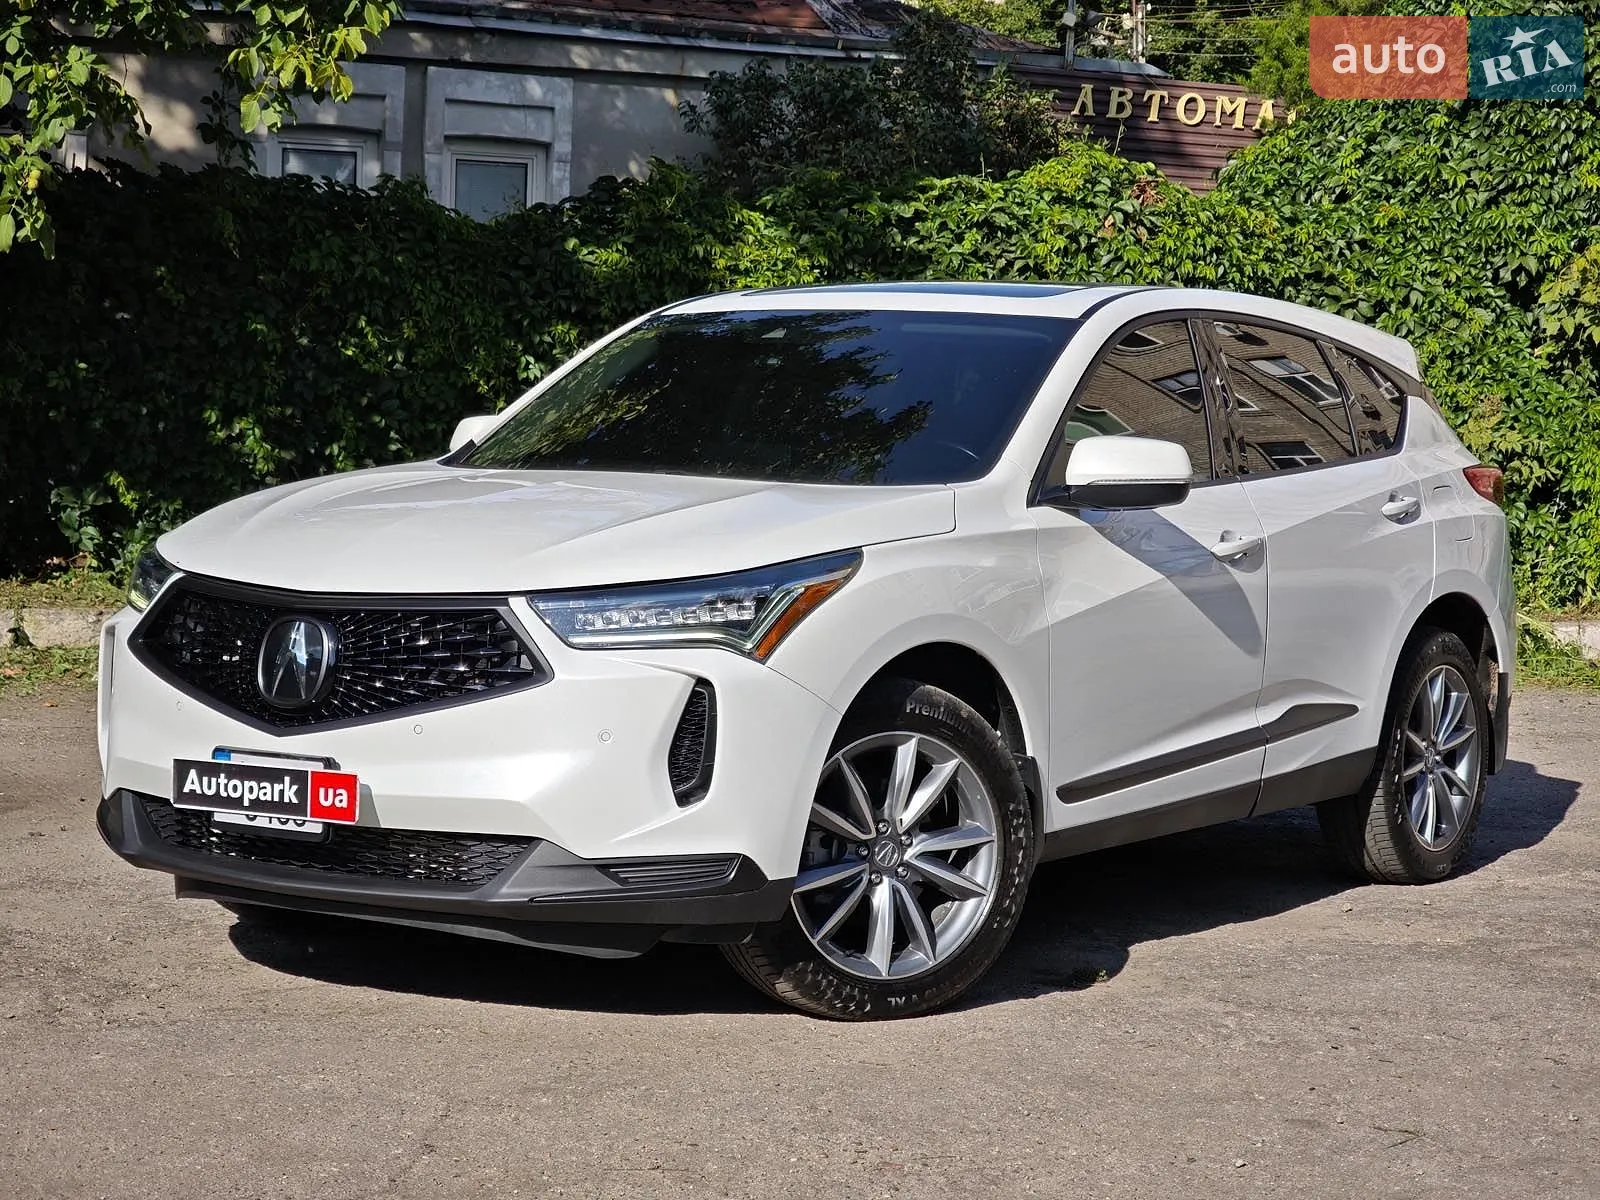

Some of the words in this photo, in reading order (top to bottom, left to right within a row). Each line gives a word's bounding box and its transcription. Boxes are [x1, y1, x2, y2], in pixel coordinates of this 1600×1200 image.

[1071, 84, 1297, 131] АВТОМА
[182, 768, 299, 806] Autopark
[318, 786, 349, 809] ua
